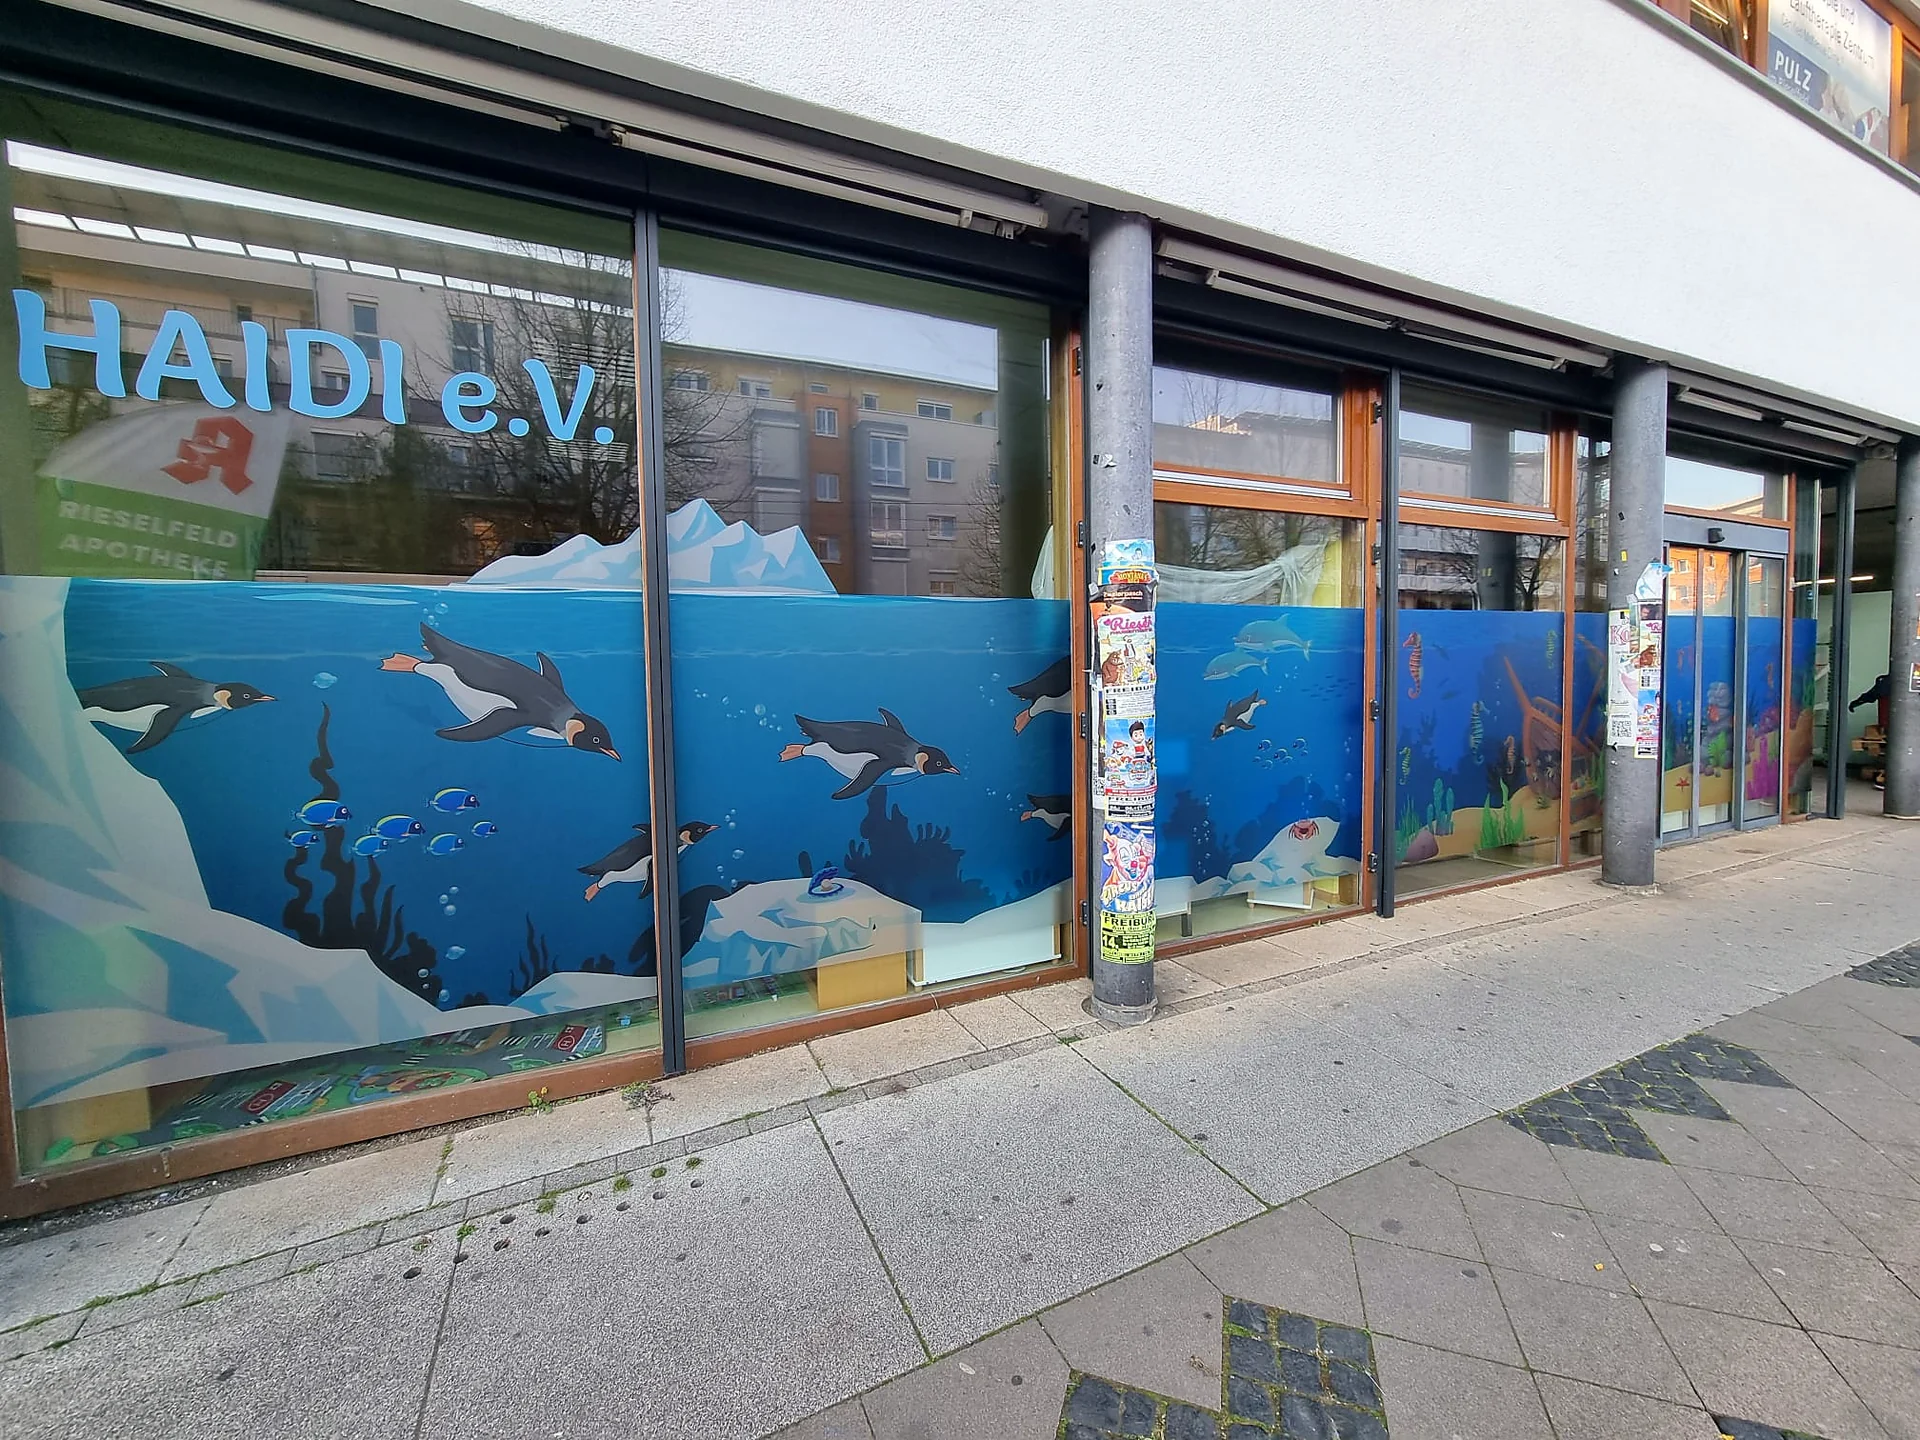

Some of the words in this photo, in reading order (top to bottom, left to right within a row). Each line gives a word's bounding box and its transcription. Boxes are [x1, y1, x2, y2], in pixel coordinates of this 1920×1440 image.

[1774, 50, 1812, 92] PULZ
[13, 288, 408, 426] HAIDI
[441, 358, 616, 445] e.V.
[58, 500, 238, 549] RIESELFELD
[59, 535, 228, 581] APOTHEKE
[1104, 915, 1154, 926] FREIBUR
